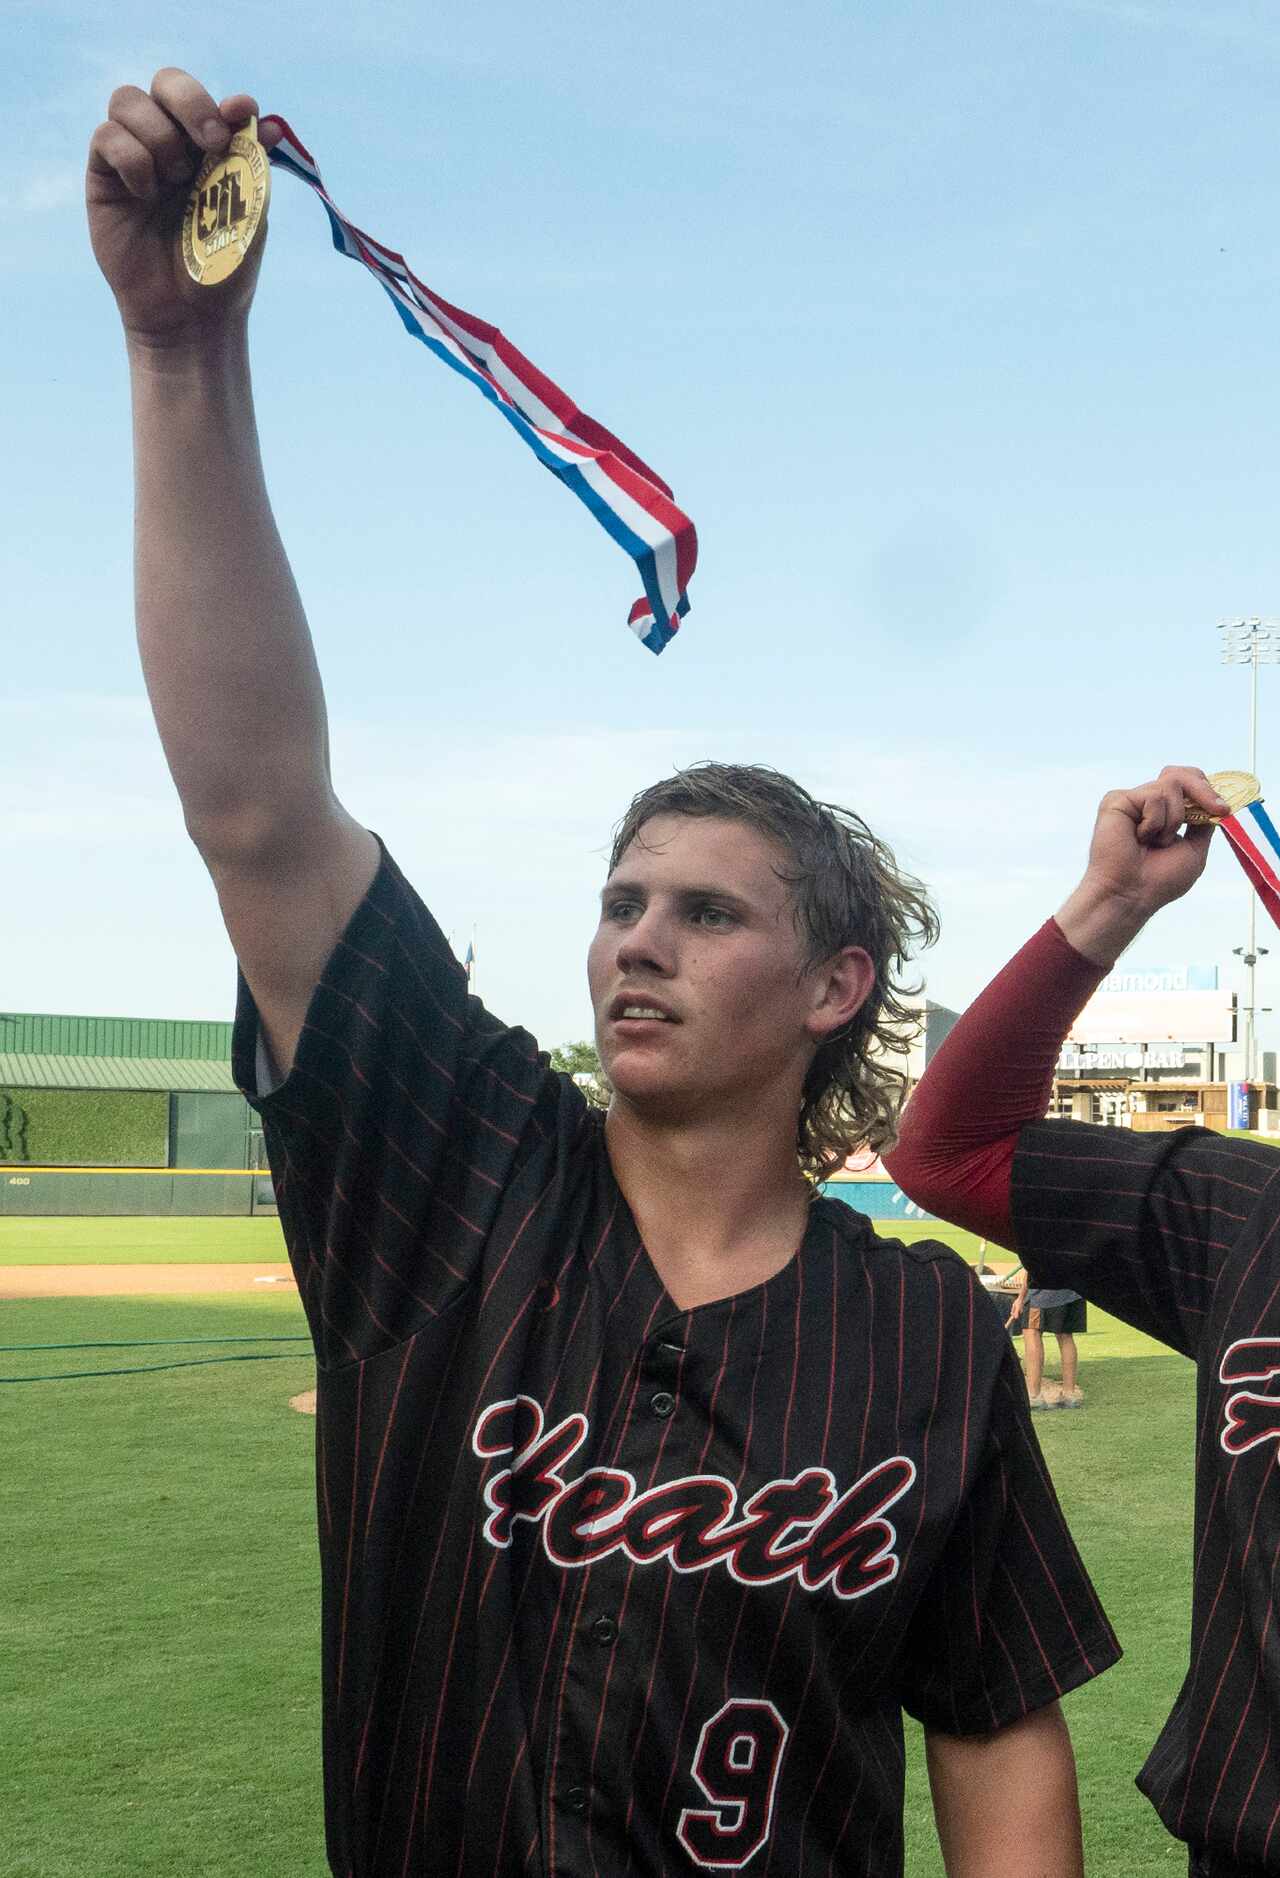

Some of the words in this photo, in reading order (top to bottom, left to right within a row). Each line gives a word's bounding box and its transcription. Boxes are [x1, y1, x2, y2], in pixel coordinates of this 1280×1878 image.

[1143, 1052, 1185, 1069] BAR
[9, 1177, 31, 1185] 400
[473, 1394, 916, 1599] Heath
[676, 1698, 788, 1868] 9
